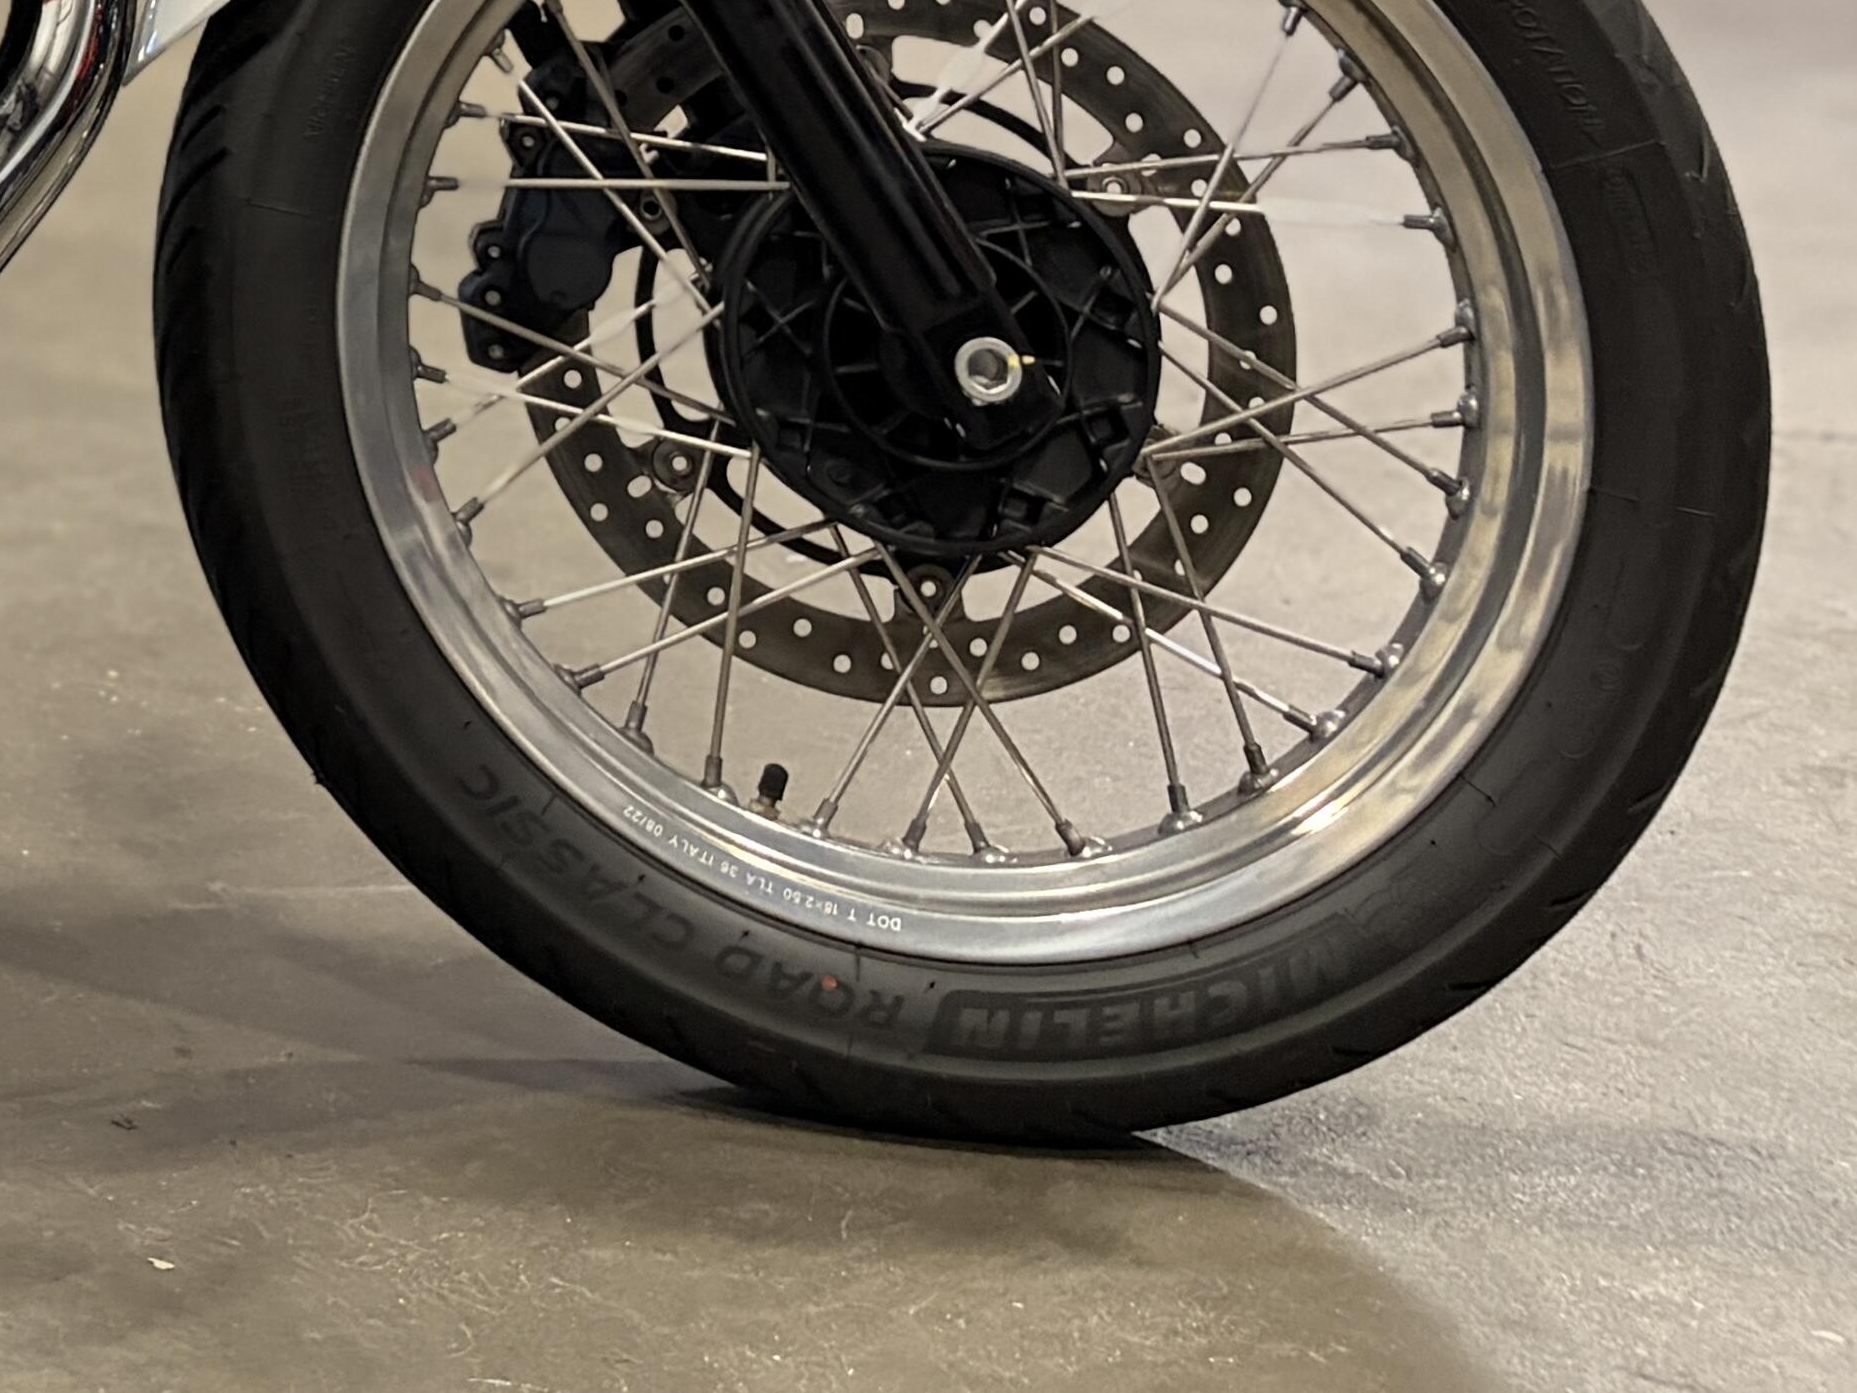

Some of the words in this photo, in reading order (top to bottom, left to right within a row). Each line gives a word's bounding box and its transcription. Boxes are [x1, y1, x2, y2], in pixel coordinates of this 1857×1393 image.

[621, 803, 664, 836] 08/22
[453, 764, 695, 950] CLASSIC
[666, 833, 714, 867] ITALY
[719, 859, 738, 878] 36
[745, 872, 773, 895] TLA
[846, 907, 857, 921] T
[866, 912, 902, 932] DOT
[716, 942, 905, 1028] ROAD
[951, 938, 1347, 1050] MICHELIN
